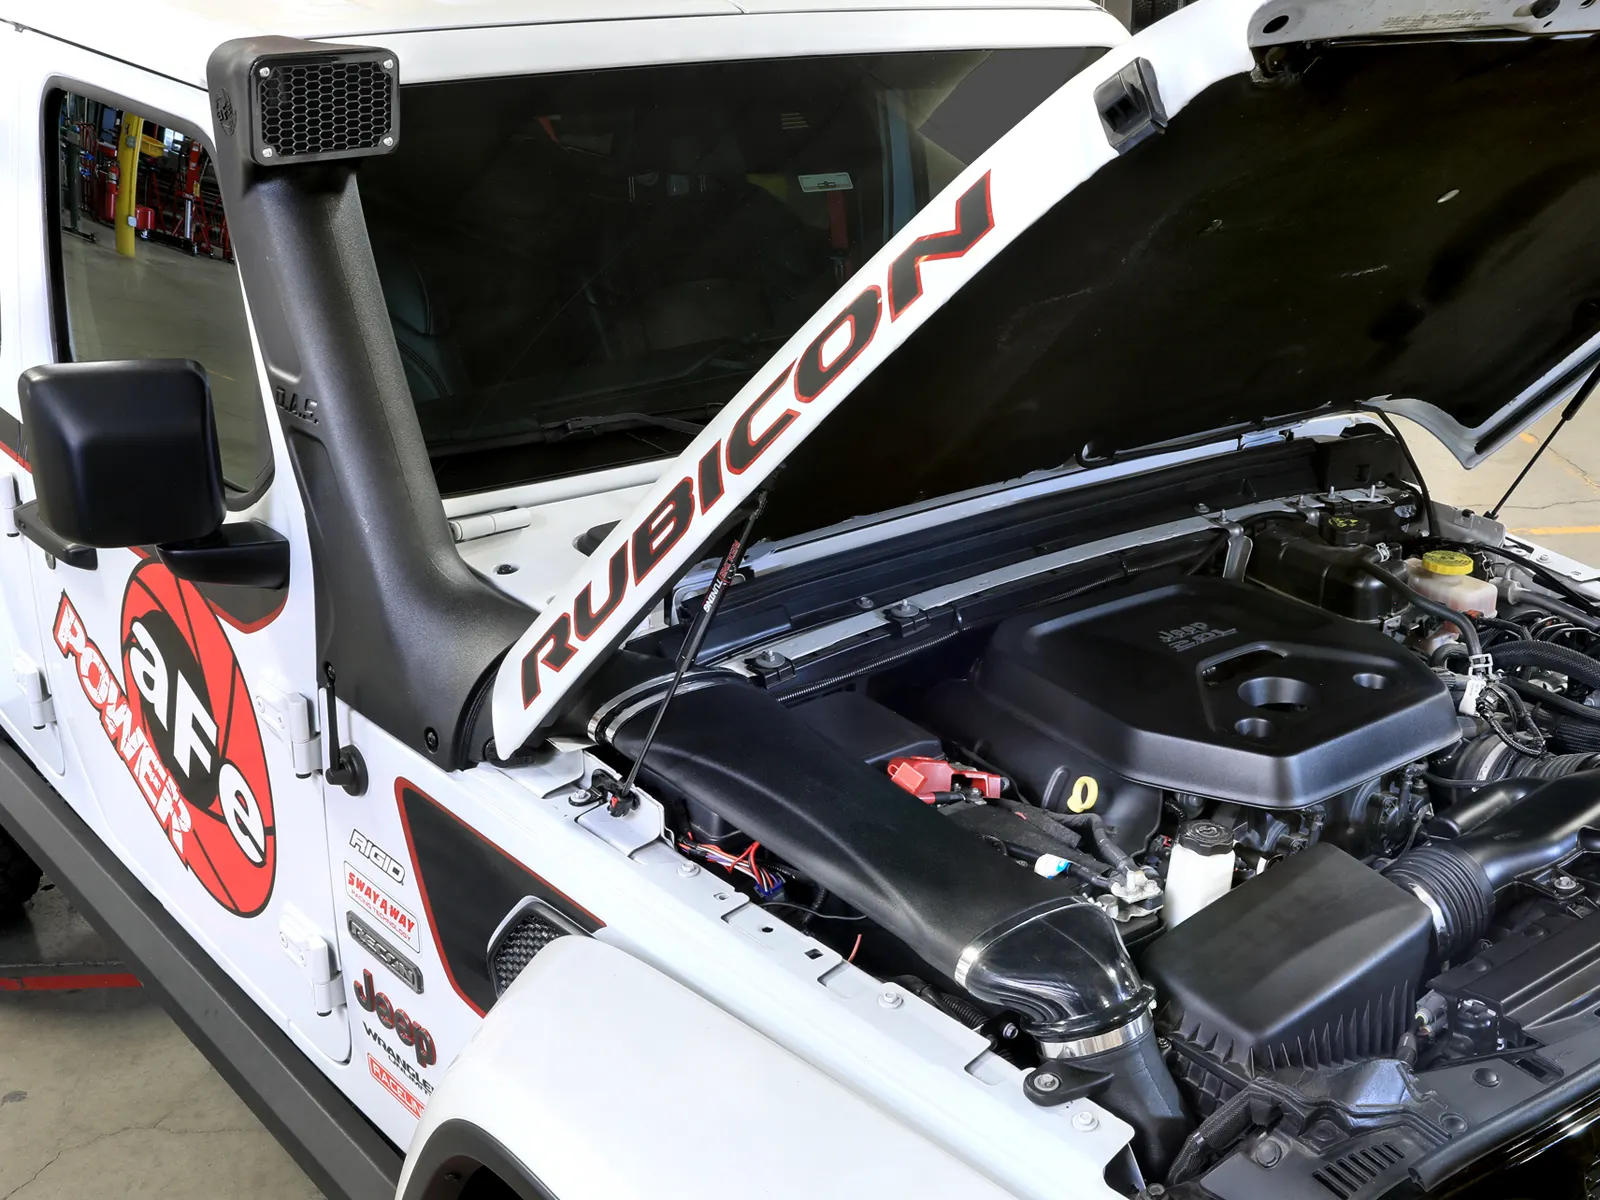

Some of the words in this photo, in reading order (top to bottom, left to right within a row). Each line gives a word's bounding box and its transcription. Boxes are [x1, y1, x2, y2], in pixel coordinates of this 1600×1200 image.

[520, 168, 995, 710] RUBICON
[703, 578, 724, 613] TUNING
[55, 594, 193, 858] POWER
[129, 620, 266, 865] aFe
[349, 828, 406, 884] RIGID
[353, 968, 437, 1068] Jeep
[362, 1020, 435, 1095] WRANGLE
[371, 1060, 425, 1118] RACELIN
